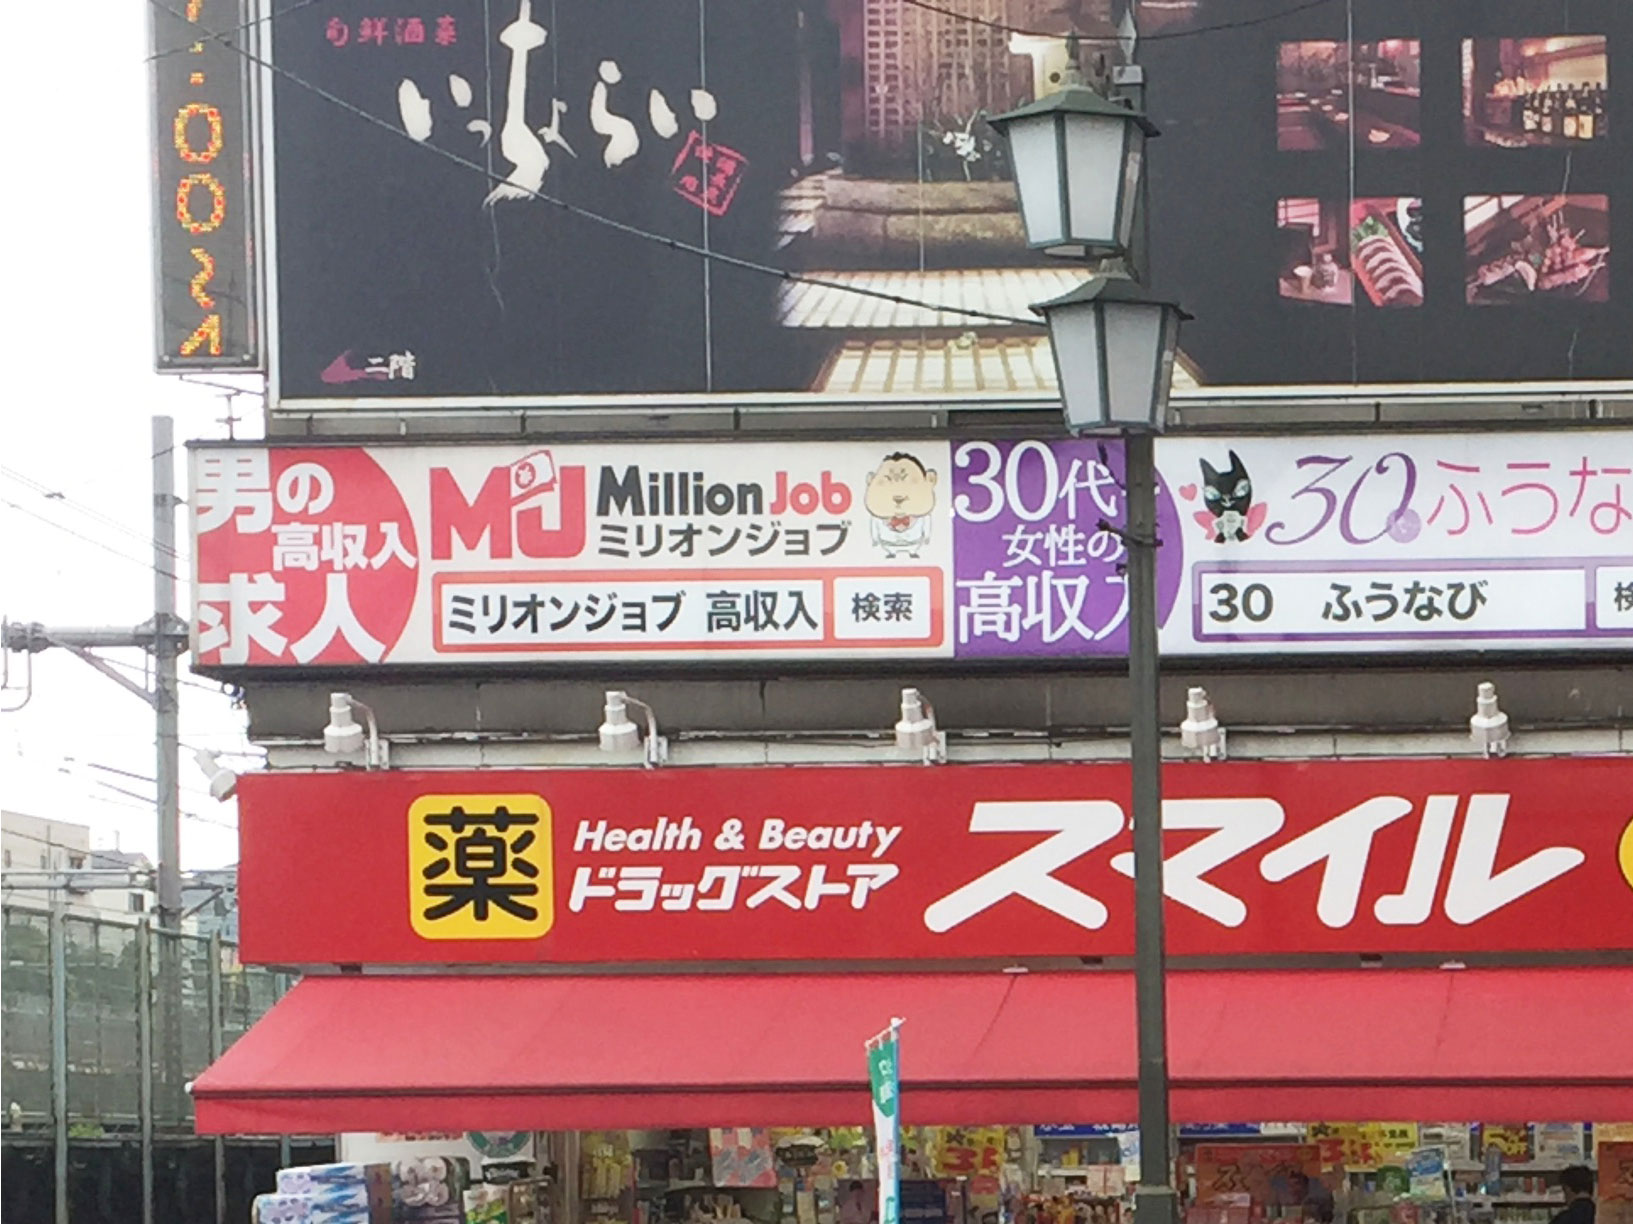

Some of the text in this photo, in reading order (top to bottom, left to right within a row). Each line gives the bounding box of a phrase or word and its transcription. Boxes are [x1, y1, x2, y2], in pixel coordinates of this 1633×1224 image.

[365, 351, 417, 382] 二階
[196, 455, 336, 537] 男の
[431, 462, 587, 560] MJ
[270, 522, 419, 572] 高収入
[595, 521, 851, 558] ミリオンジョブ
[1002, 523, 1128, 569] 女性の
[198, 571, 387, 666] 求人
[446, 591, 914, 635] ミリオンジョブ 高収入 検索
[1209, 582, 1274, 623] 30
[1321, 579, 1490, 621] ふうなび
[572, 815, 902, 861] Health & Beauty
[922, 792, 1586, 934] スマイル
[422, 806, 539, 922] 薬
[568, 862, 901, 915] ドラッグストア
